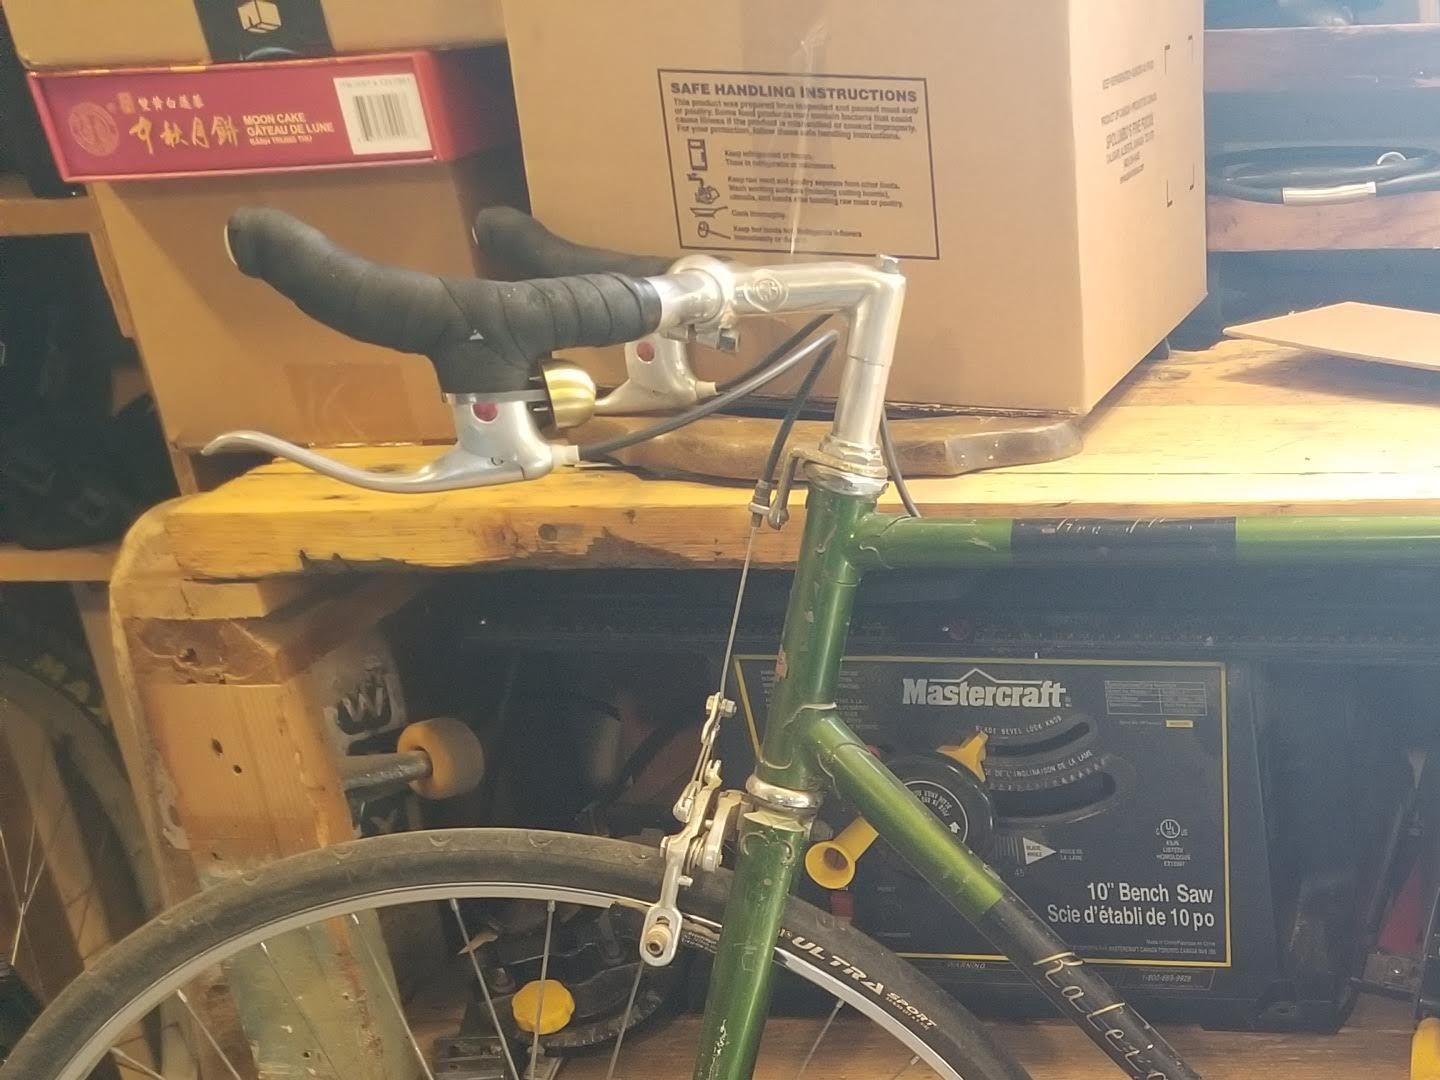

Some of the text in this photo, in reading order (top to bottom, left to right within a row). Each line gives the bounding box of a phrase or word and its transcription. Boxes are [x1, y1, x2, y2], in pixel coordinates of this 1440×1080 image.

[671, 82, 918, 102] SAFE HANDLING INSTRUCTIONS
[243, 112, 307, 126] MOON CAKE
[246, 121, 335, 136] GÂTEAU DE LUNE
[902, 678, 1067, 708] Mastercraft
[1088, 882, 1213, 904] 10" Bench Saw
[1047, 904, 1215, 931] Scie d'établi de 10 po
[792, 936, 884, 995] ULTRA
[886, 993, 937, 1027] SPORT
